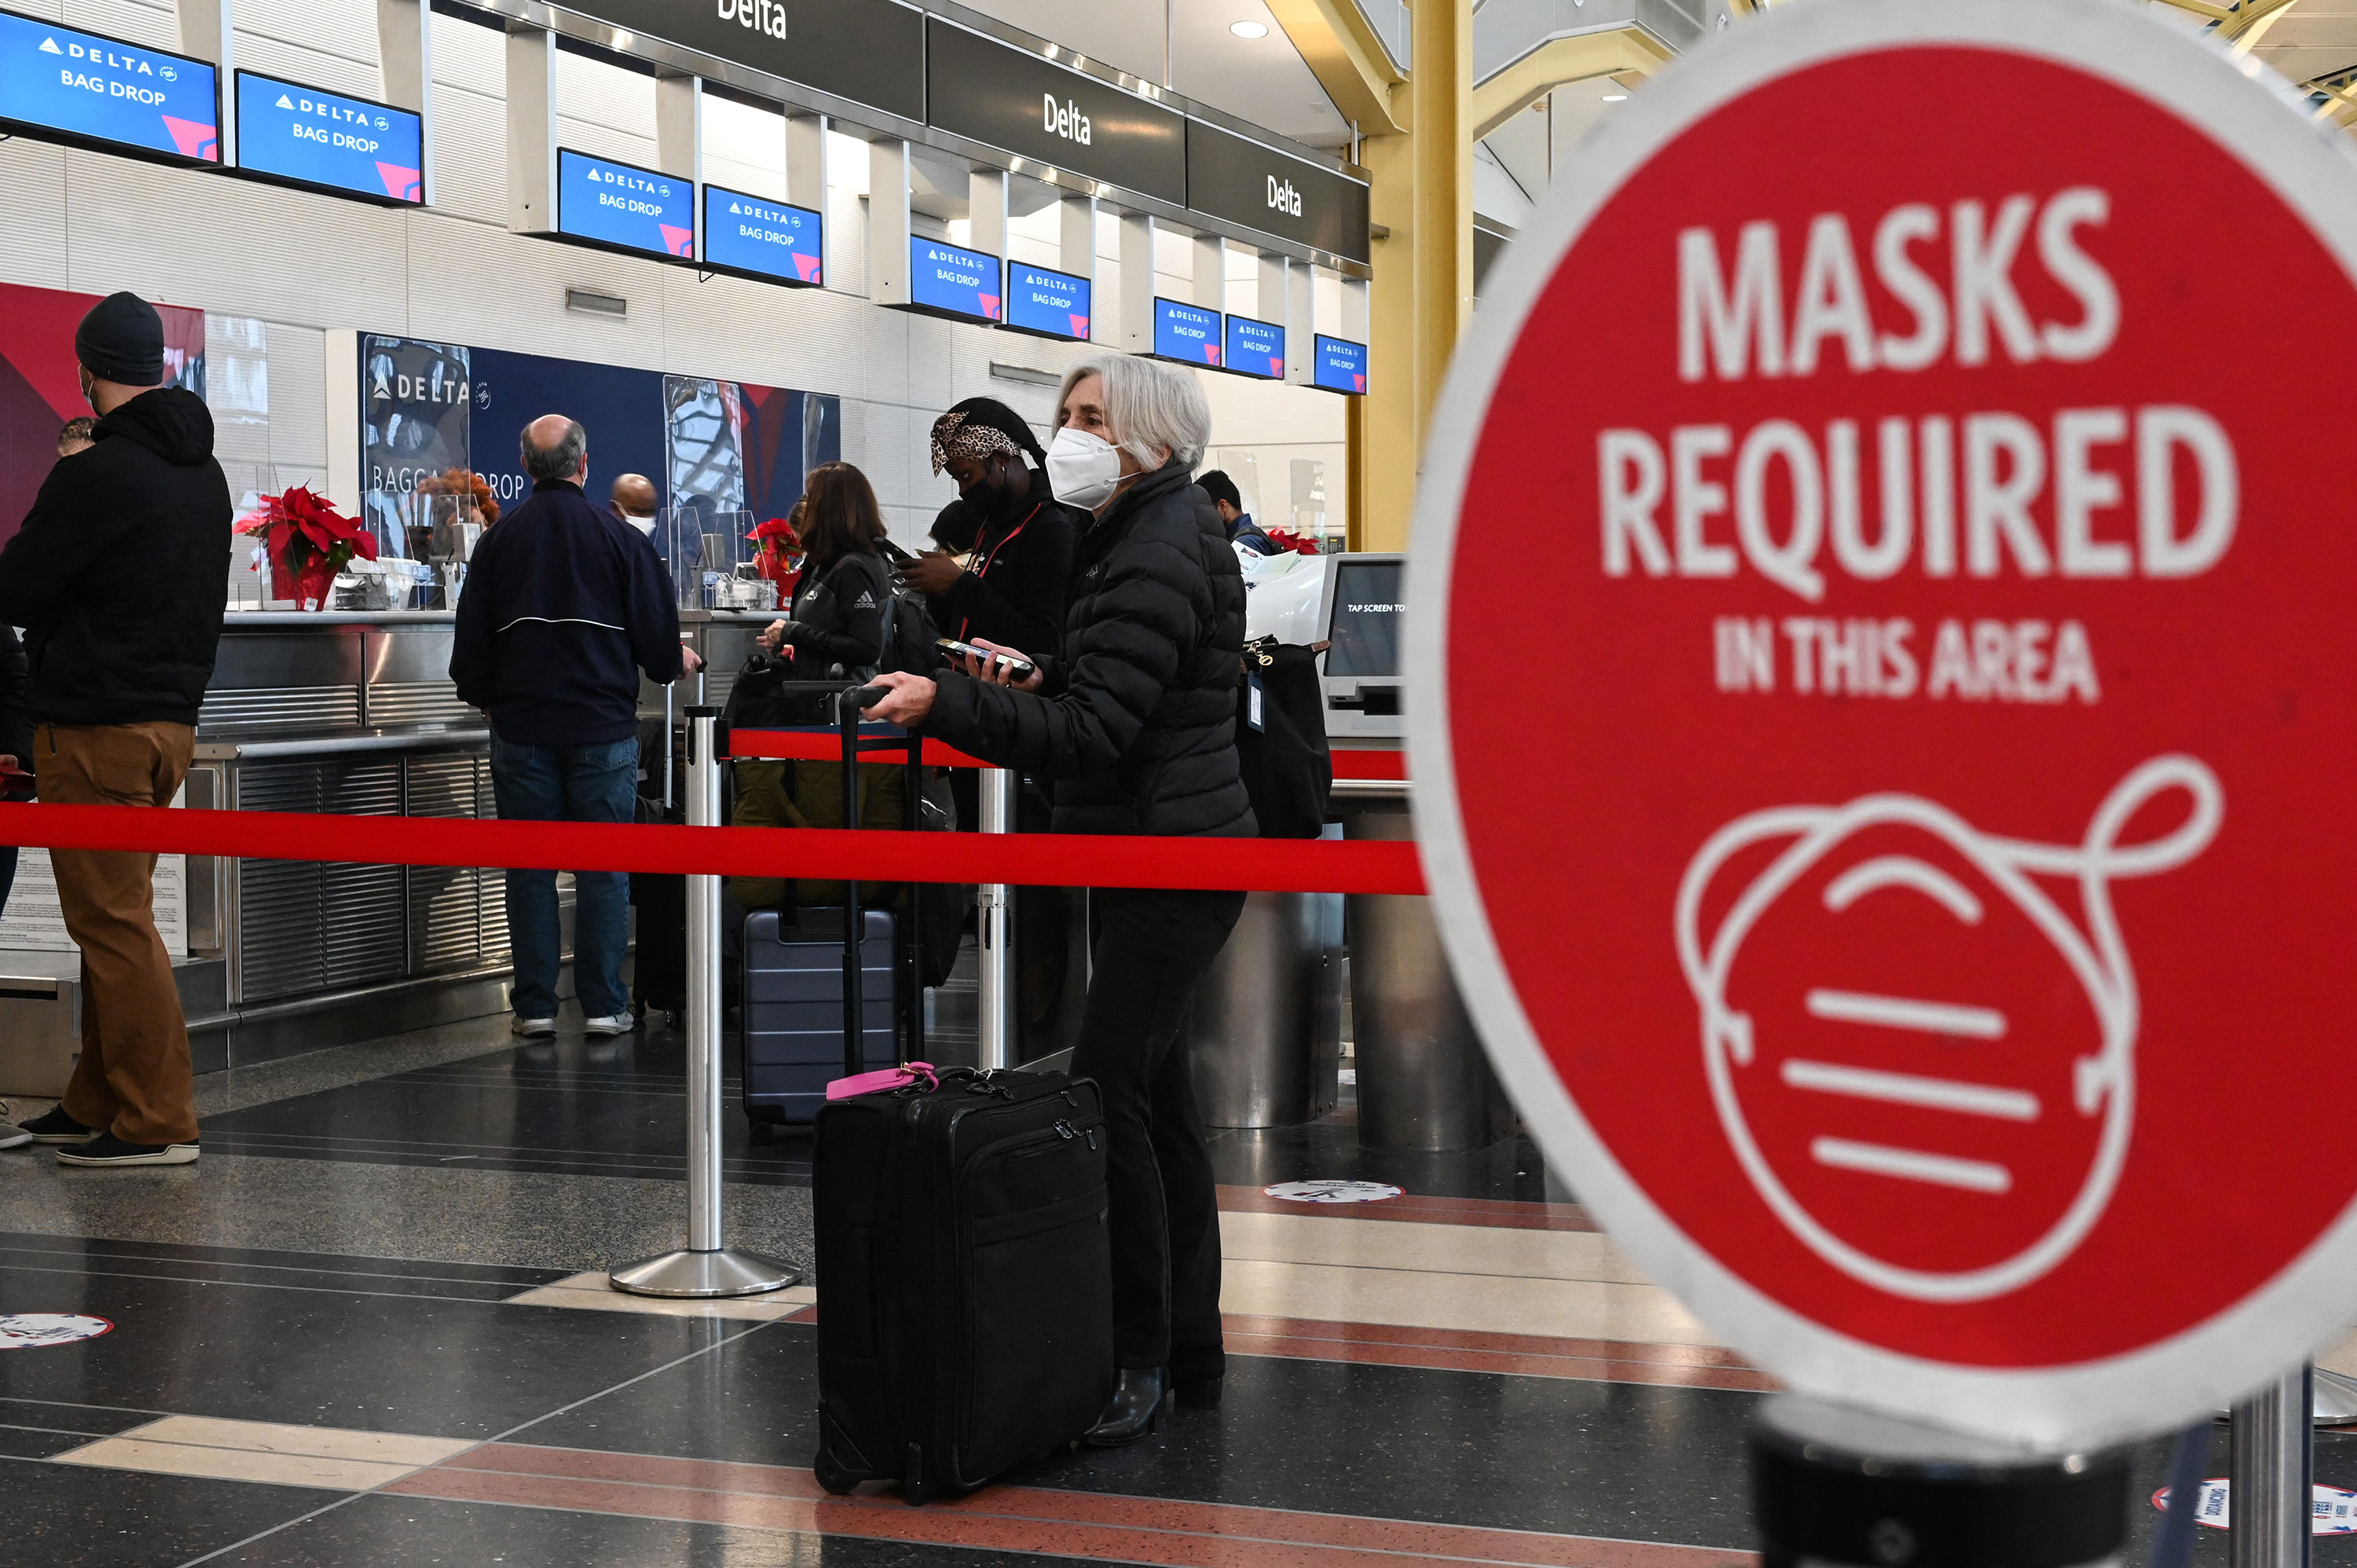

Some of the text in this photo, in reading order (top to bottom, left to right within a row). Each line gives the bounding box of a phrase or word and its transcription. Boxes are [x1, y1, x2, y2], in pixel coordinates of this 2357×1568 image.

[69, 43, 152, 76] DELTA
[61, 70, 165, 106] BAG DROP
[300, 99, 368, 126] DELTA
[1044, 93, 1091, 145] Delta
[293, 123, 379, 153] BAG DROP
[605, 172, 654, 193] DELTA
[599, 193, 662, 217] BAG DROP
[1267, 174, 1301, 217] Delta
[745, 206, 787, 224] DELTA
[739, 225, 794, 246] BAG DROP
[940, 251, 974, 268] DELTA
[937, 269, 980, 288] BAG DROP
[1036, 277, 1068, 291] DELTA
[1677, 187, 2121, 382] MASKS
[1032, 293, 1072, 309] BAG DROP
[1176, 310, 1202, 323] DELTA
[1174, 325, 1206, 339] BAG DROP
[1245, 327, 1269, 338] DELTA
[1243, 340, 1271, 353] BAG DROP
[1332, 345, 1353, 356] DELTA
[1329, 357, 1355, 369] BAG DROP
[398, 374, 469, 405] DELTA
[1597, 405, 2239, 602] REQUIRED
[1714, 617, 2100, 703] IN THIS AREA
